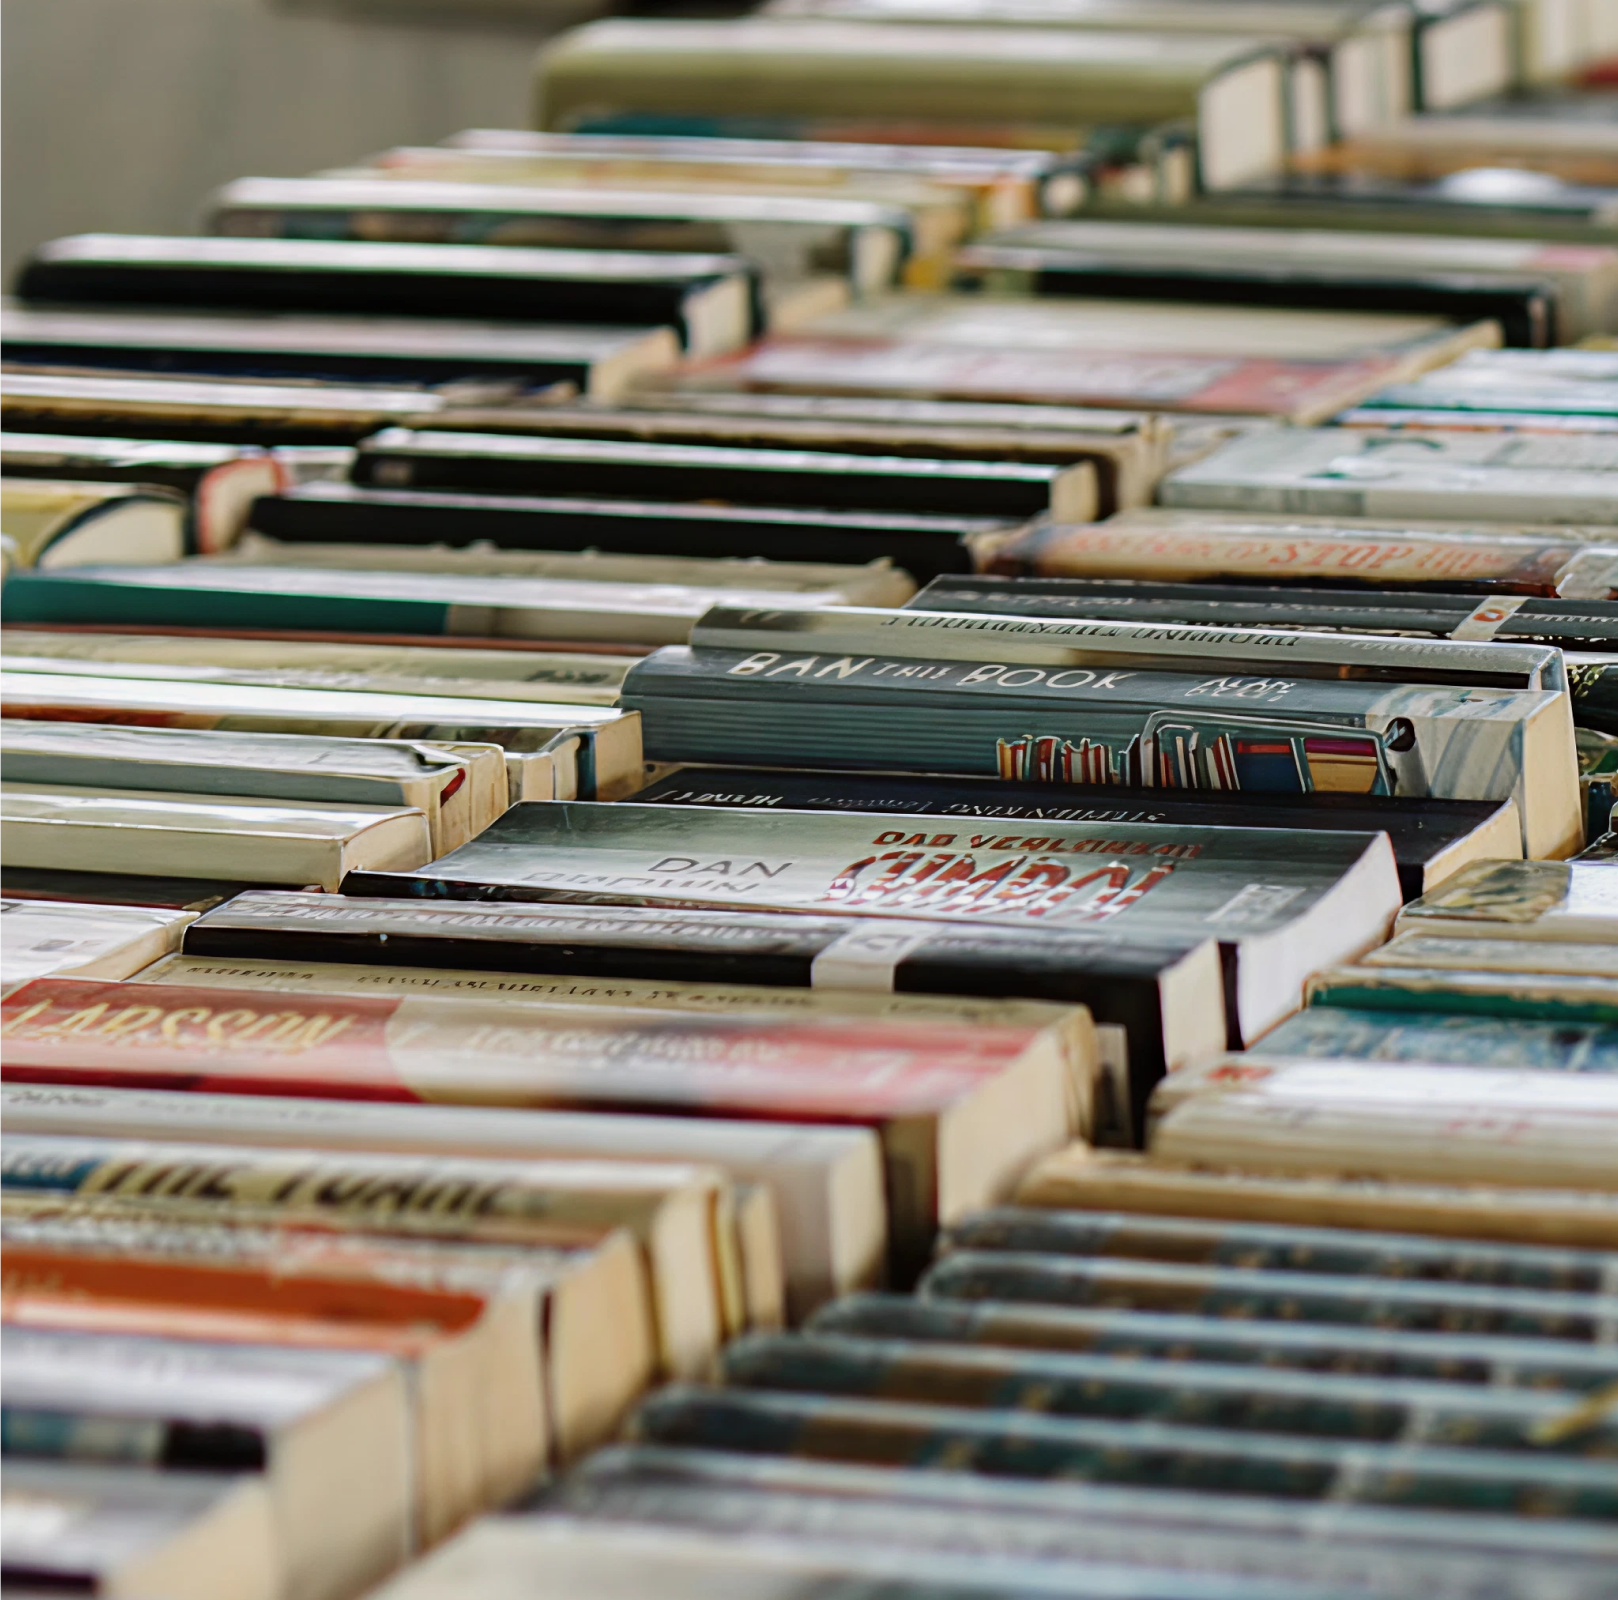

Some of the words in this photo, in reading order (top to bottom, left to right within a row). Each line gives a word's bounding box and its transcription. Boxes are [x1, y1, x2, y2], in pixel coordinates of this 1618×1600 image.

[726, 652, 876, 679] BAN
[956, 664, 1138, 690] BOOK
[647, 856, 794, 880] DAN
